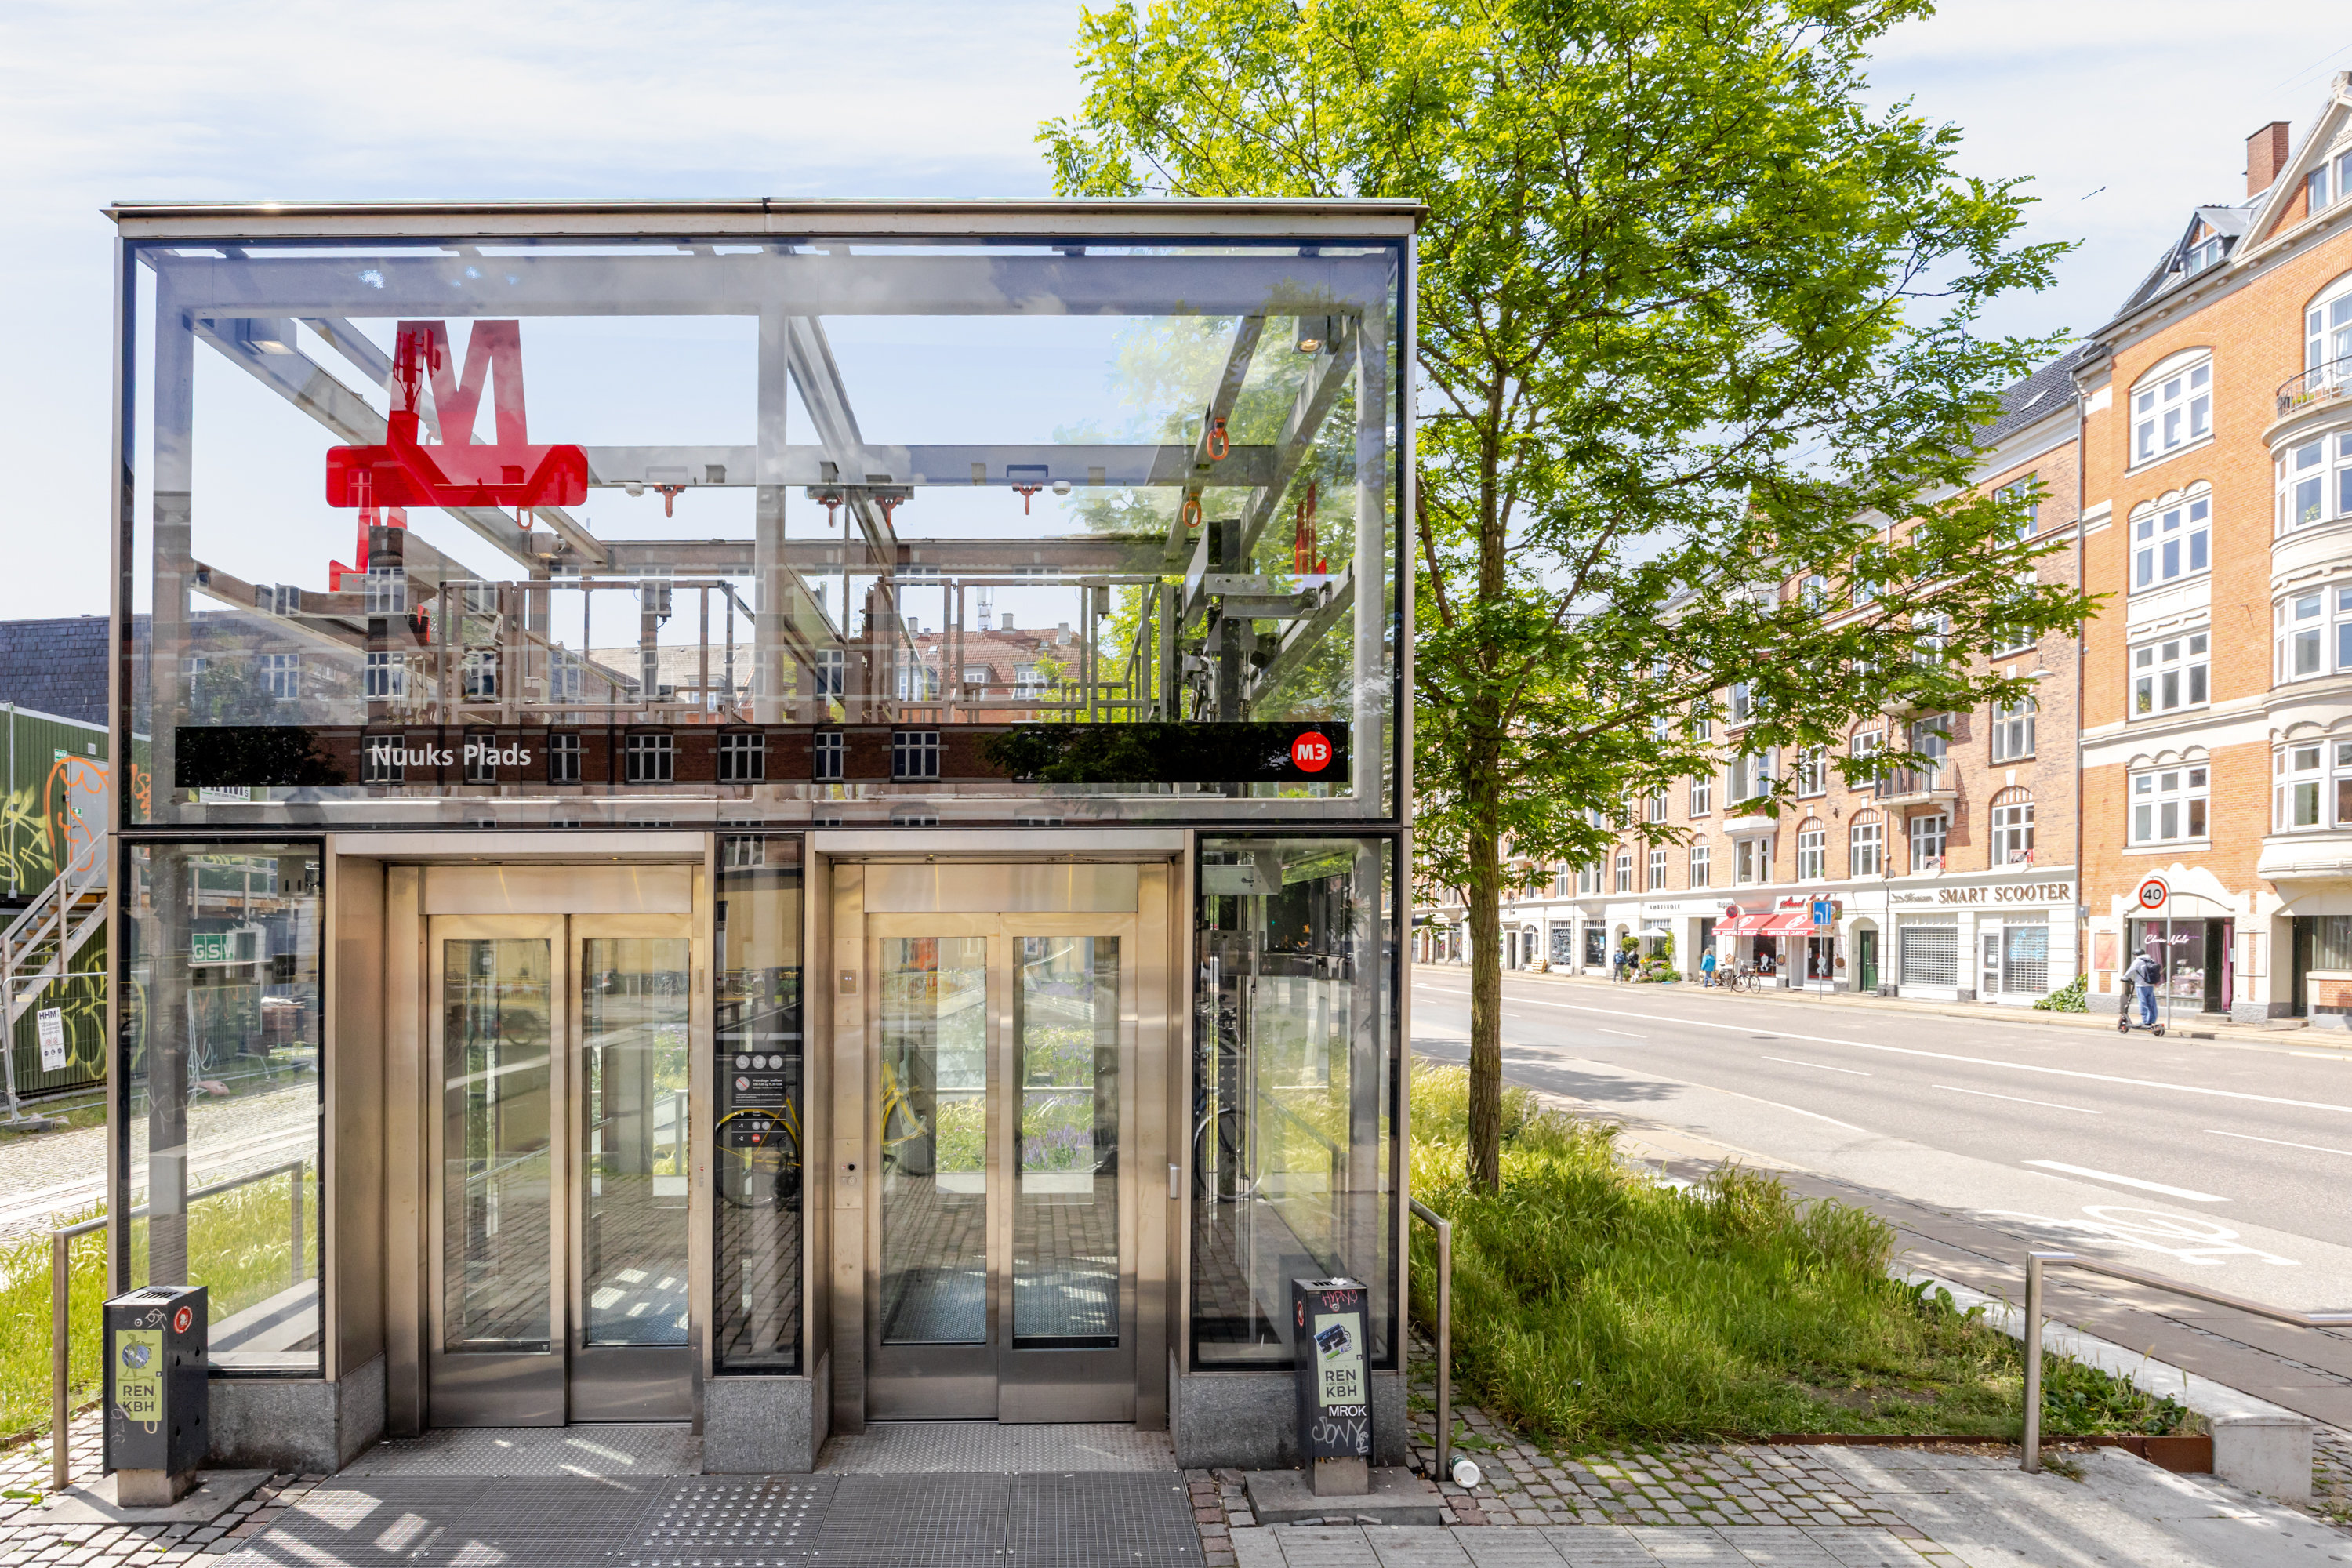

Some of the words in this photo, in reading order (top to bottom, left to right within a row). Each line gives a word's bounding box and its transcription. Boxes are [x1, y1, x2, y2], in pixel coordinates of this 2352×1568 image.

[372, 743, 454, 766] Nuuks
[464, 743, 532, 766] Plads
[1297, 744, 1327, 760] M3
[1939, 887, 1988, 904] SMART
[1994, 884, 2071, 902] SCOOTER
[2143, 888, 2161, 900] 40
[194, 944, 232, 959] GSV
[39, 1010, 56, 1020] HHM
[1325, 1369, 1356, 1381] REN
[123, 1385, 154, 1396] REN
[1326, 1385, 1357, 1398] KBH
[123, 1401, 154, 1412] KBH
[1328, 1405, 1367, 1417] MROK
